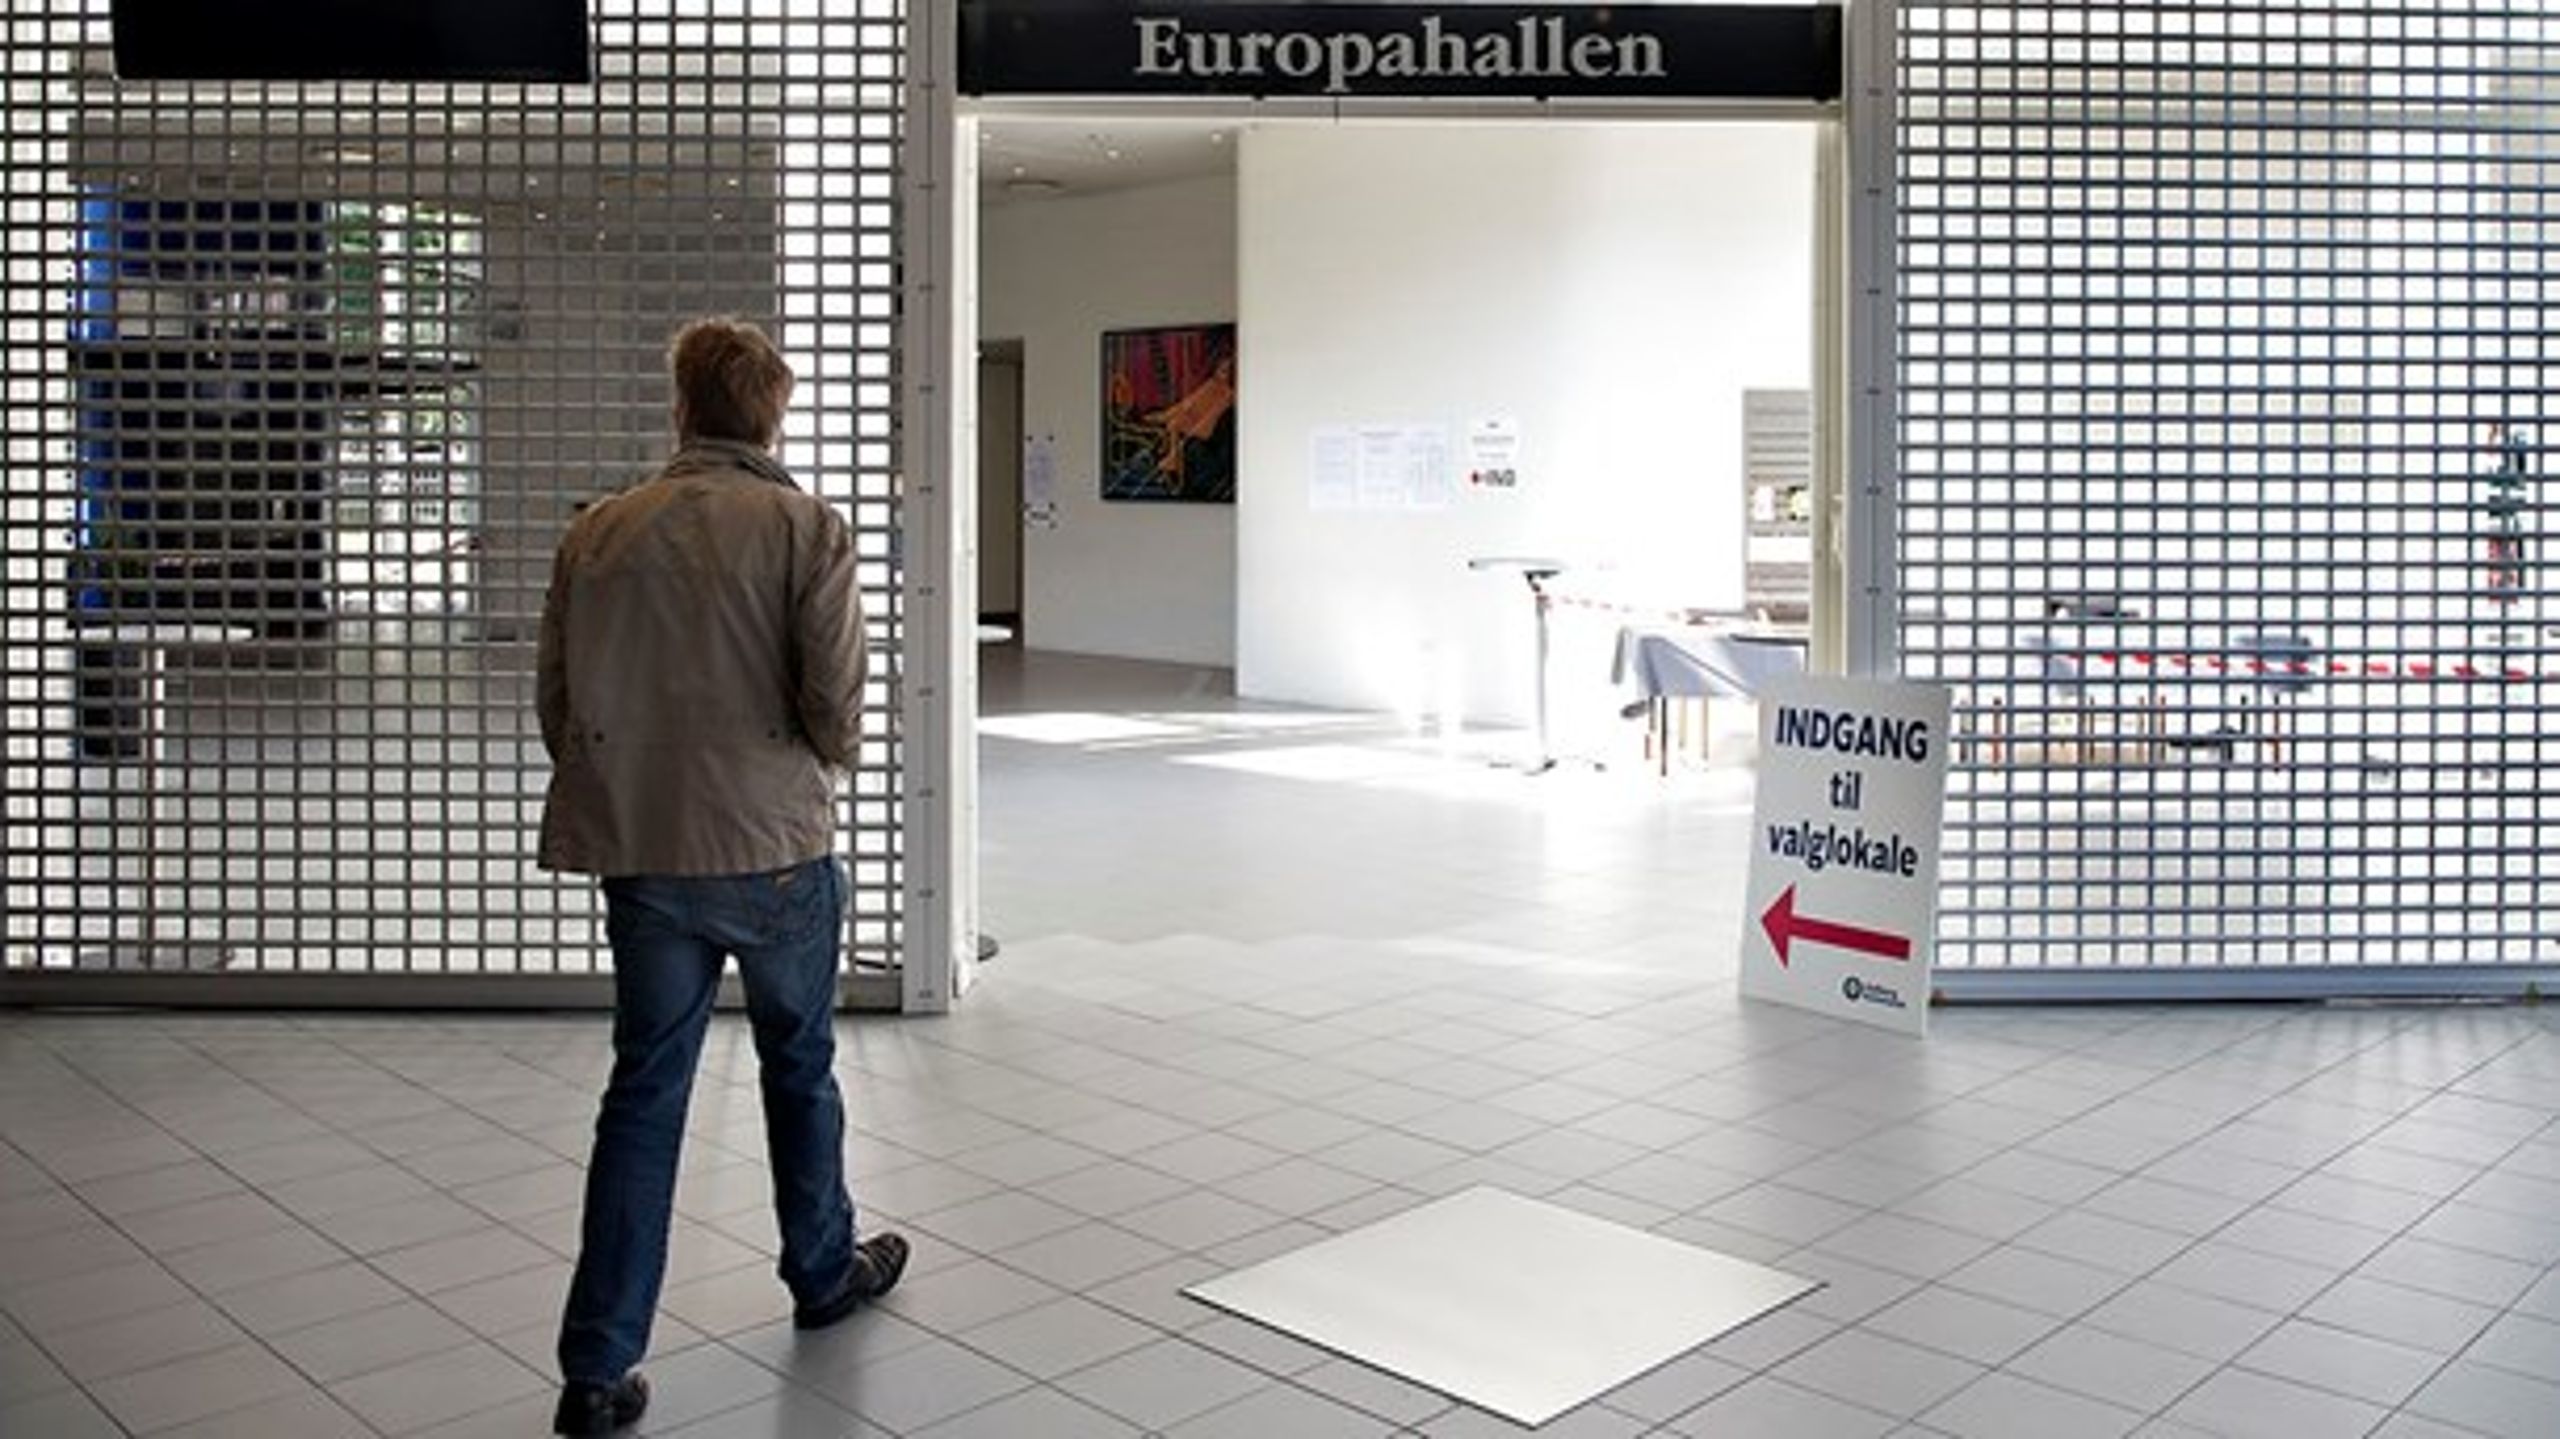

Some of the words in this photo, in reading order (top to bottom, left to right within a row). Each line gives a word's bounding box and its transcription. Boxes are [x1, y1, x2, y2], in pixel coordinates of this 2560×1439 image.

[1134, 16, 1667, 93] Europahallen
[1775, 707, 1928, 762] INDGANG
[1829, 770, 1861, 810] til
[1767, 820, 1919, 878] valglokale
